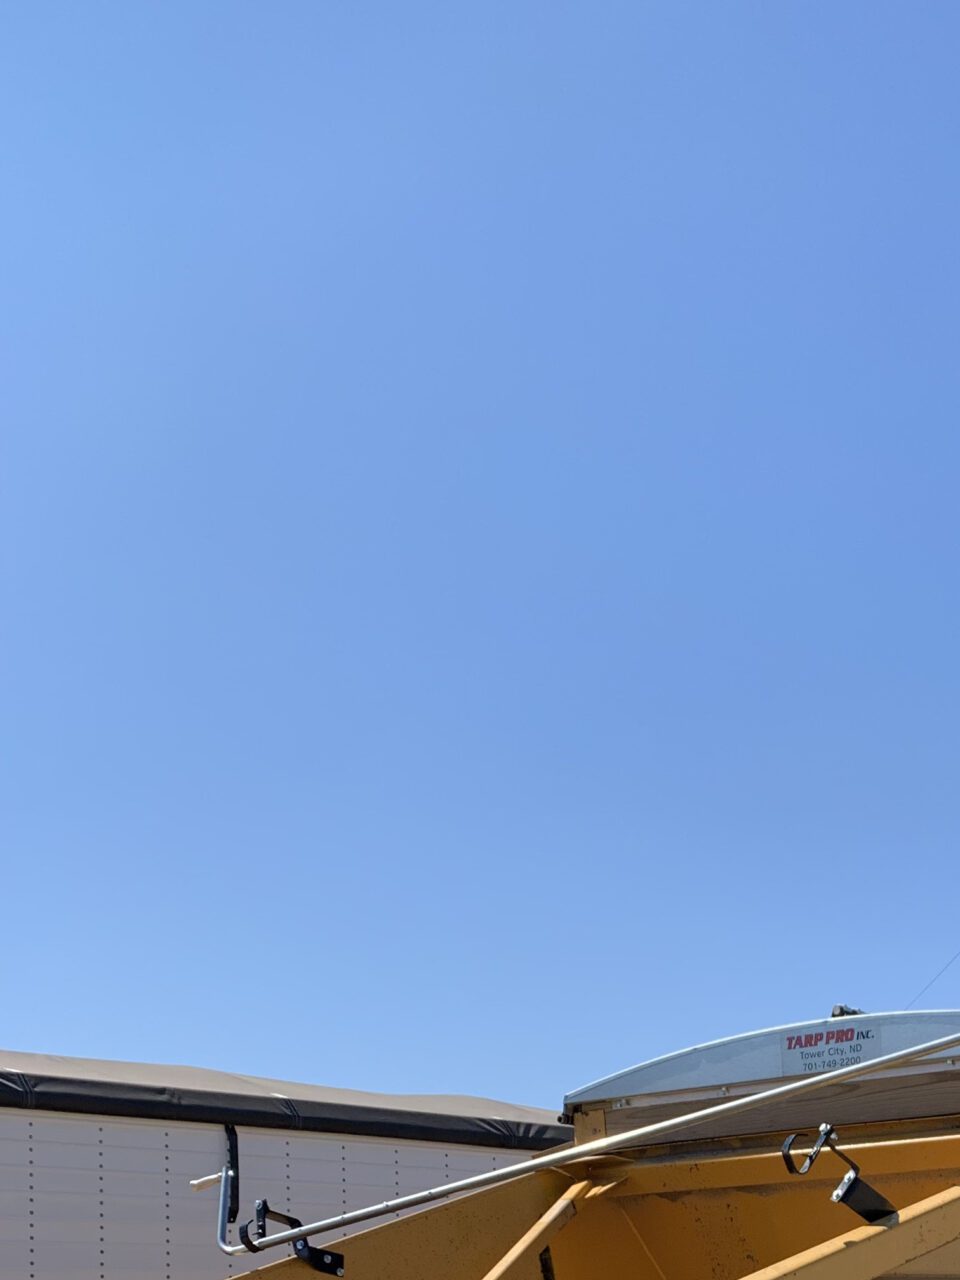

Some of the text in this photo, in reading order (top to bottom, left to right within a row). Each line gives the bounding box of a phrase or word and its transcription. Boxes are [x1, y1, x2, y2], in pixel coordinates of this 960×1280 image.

[786, 1028, 875, 1050] TARP PRO INC.
[800, 1050, 825, 1060] Tower
[849, 1043, 862, 1053] ND
[803, 1056, 861, 1071] 701-749-2200
